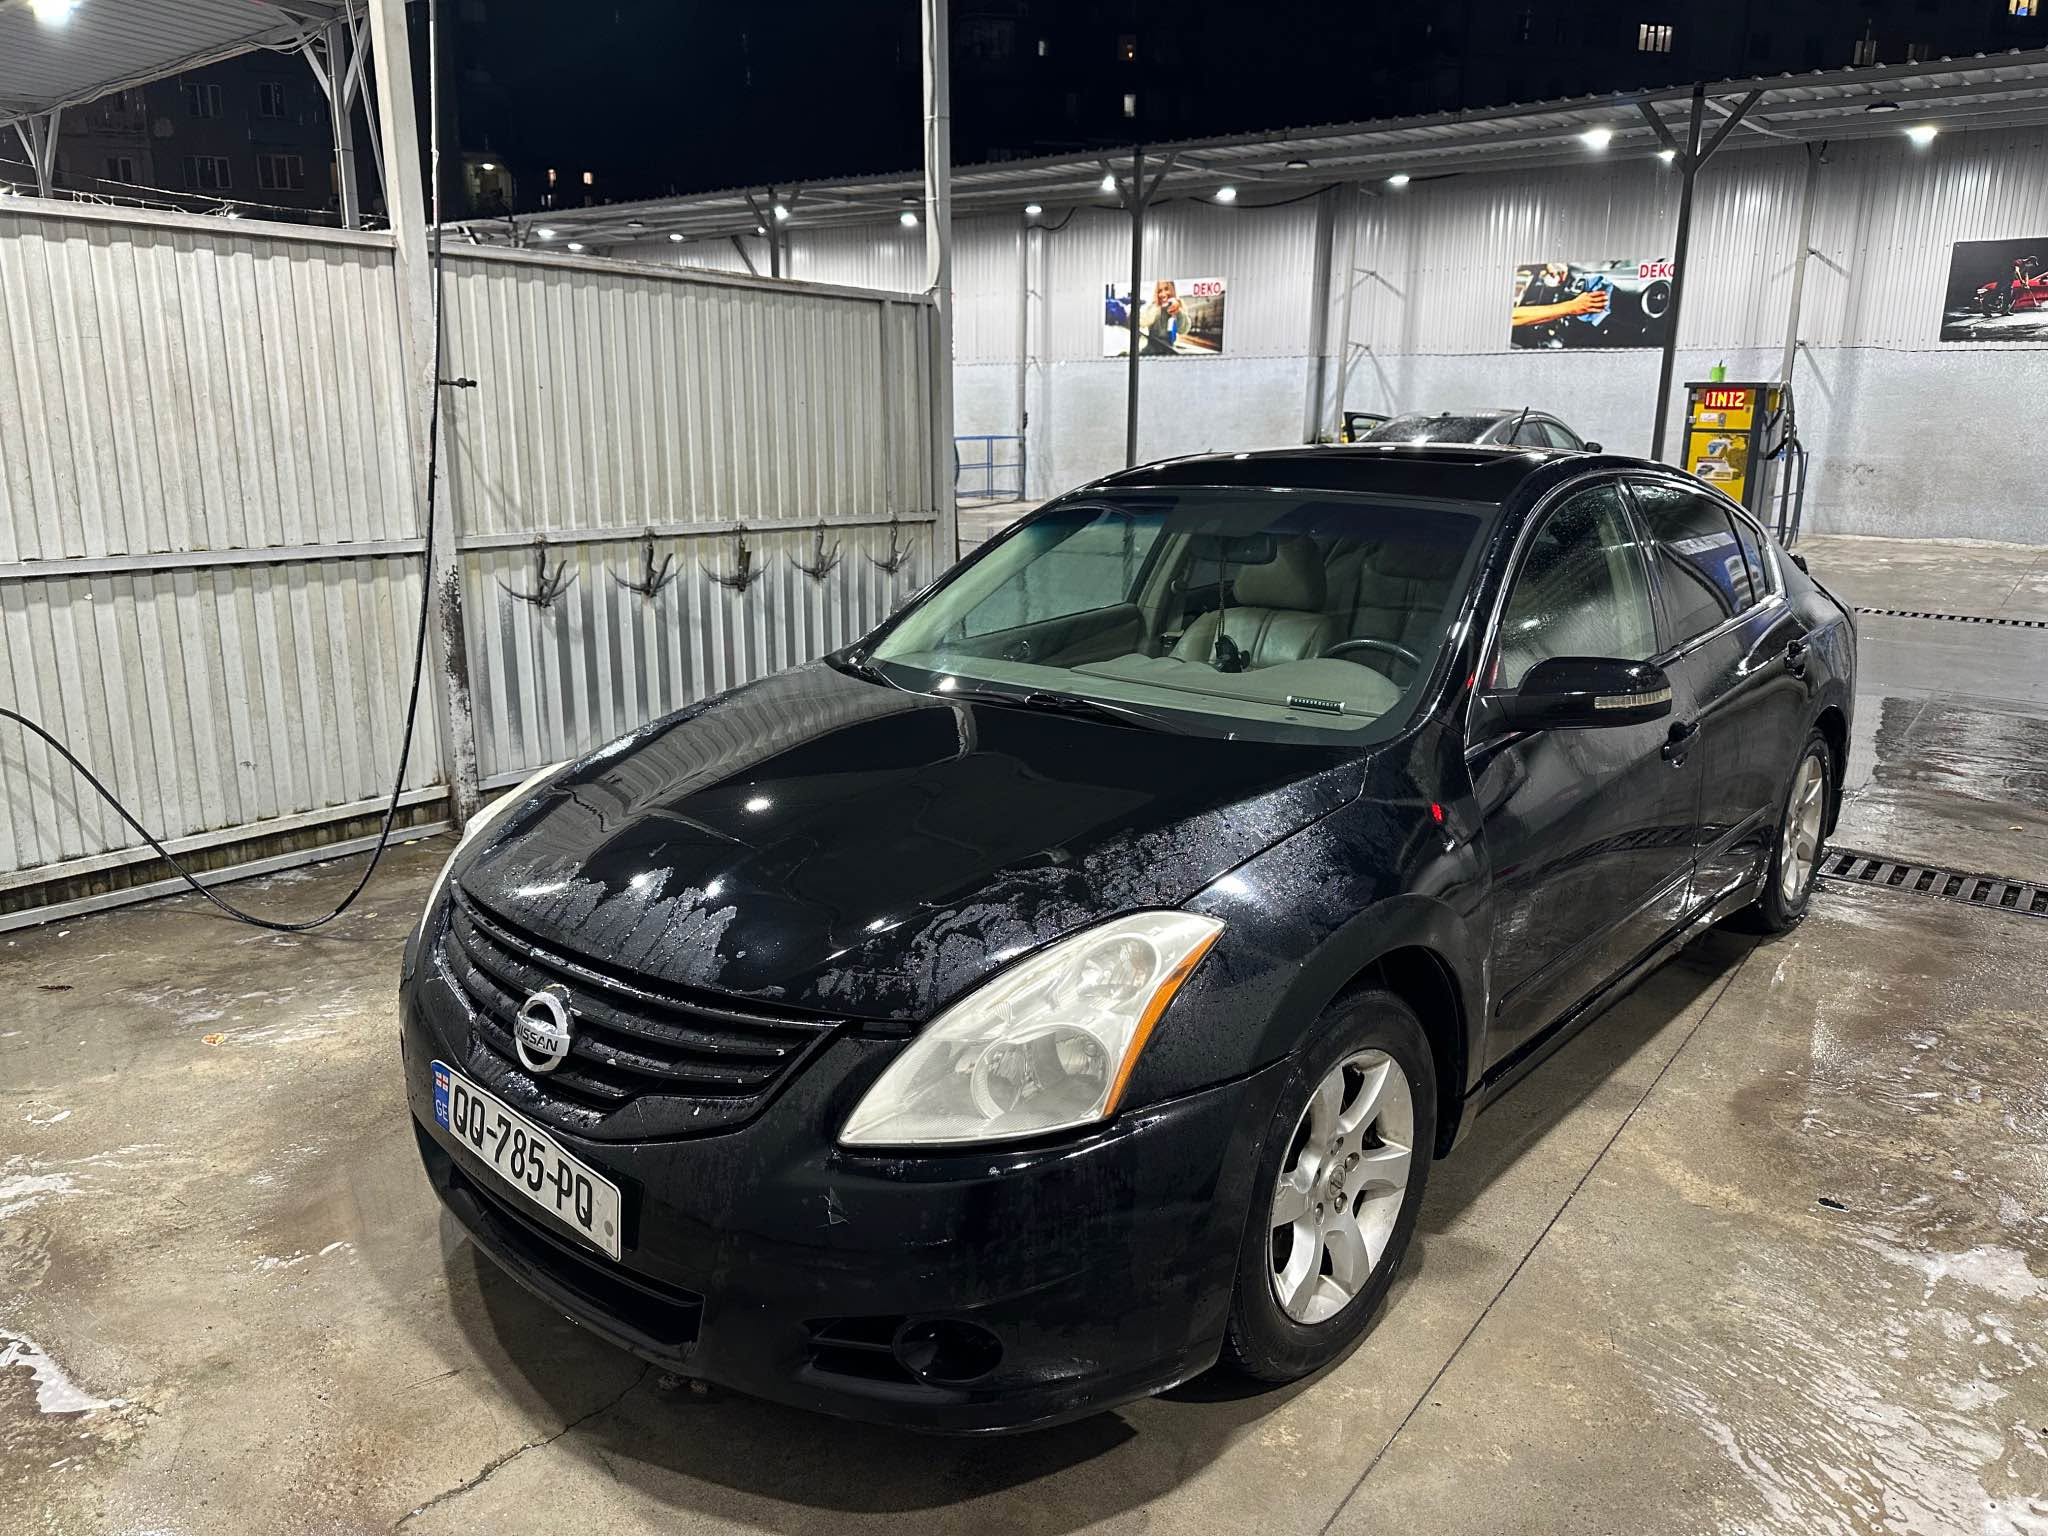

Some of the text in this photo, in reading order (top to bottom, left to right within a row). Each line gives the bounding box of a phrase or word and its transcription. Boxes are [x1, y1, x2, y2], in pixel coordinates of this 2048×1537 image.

[1638, 263, 1676, 279] DEKO
[1193, 281, 1221, 296] DEKO
[516, 1019, 558, 1052] NISSAN
[435, 1098, 449, 1122] GE
[453, 1084, 593, 1232] QQ-785-PQ
